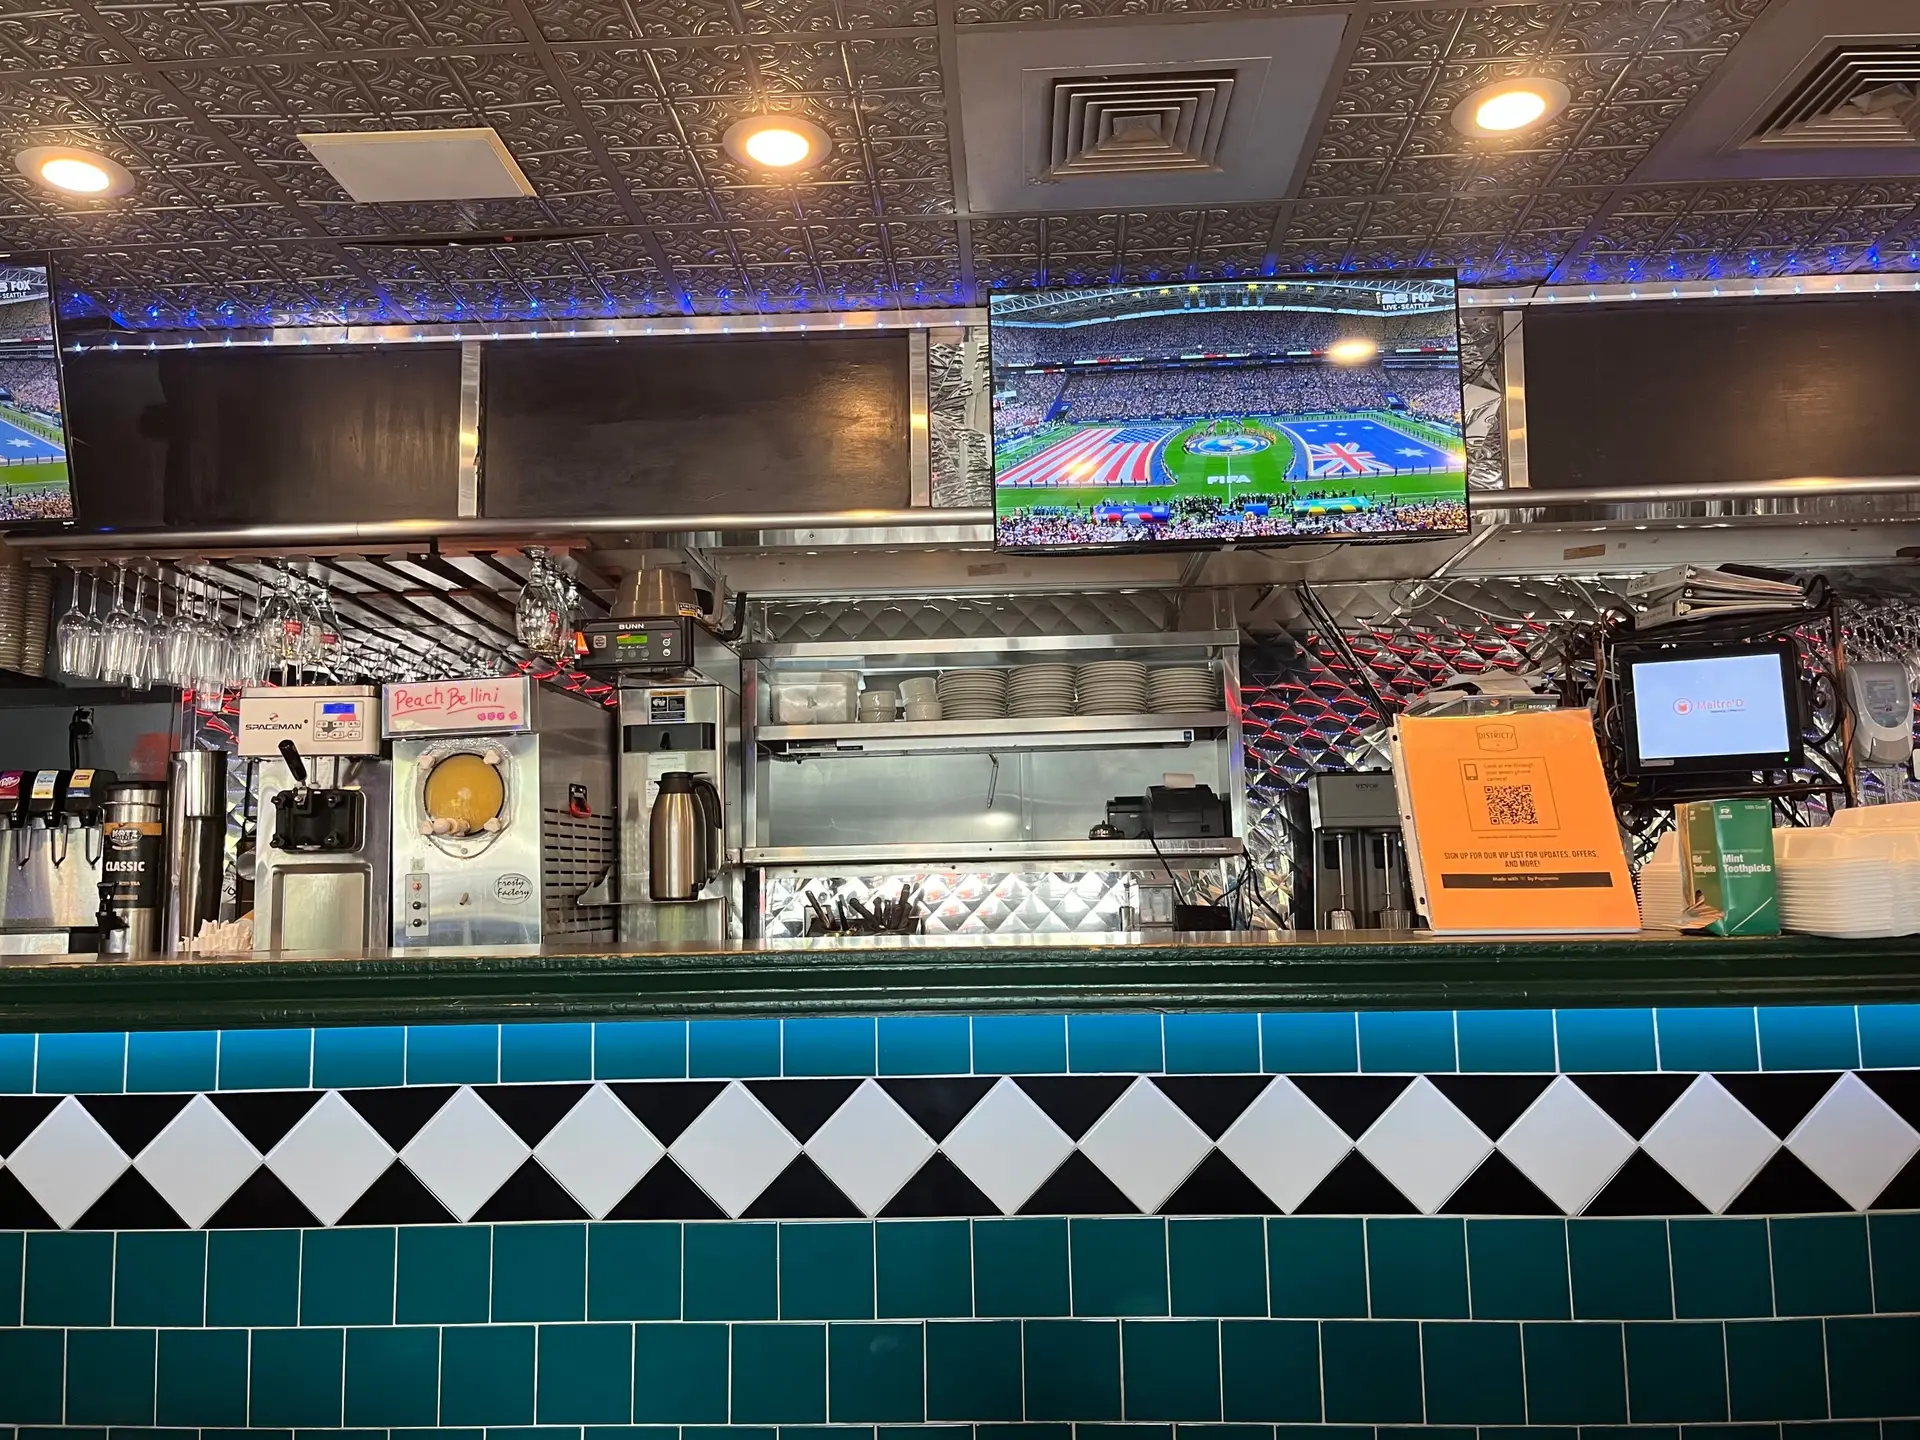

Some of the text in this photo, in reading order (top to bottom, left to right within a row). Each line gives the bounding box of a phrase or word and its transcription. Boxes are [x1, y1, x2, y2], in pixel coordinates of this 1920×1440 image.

[11, 280, 31, 292] FOX
[1411, 291, 1435, 303] FOX
[1207, 474, 1252, 485] FIFA
[394, 686, 500, 711] Peach Bellini
[245, 723, 303, 731] SPACEMAN
[1444, 852, 1459, 860] SIGN
[1484, 851, 1497, 859] OUR
[1498, 851, 1509, 859] VIP
[1722, 854, 1744, 863] Mint
[106, 861, 146, 872] CLASSIC
[1505, 860, 1519, 868] AND
[1723, 863, 1771, 874] Toothpicks
[497, 877, 525, 889] Frosty
[497, 887, 530, 898] Factory
